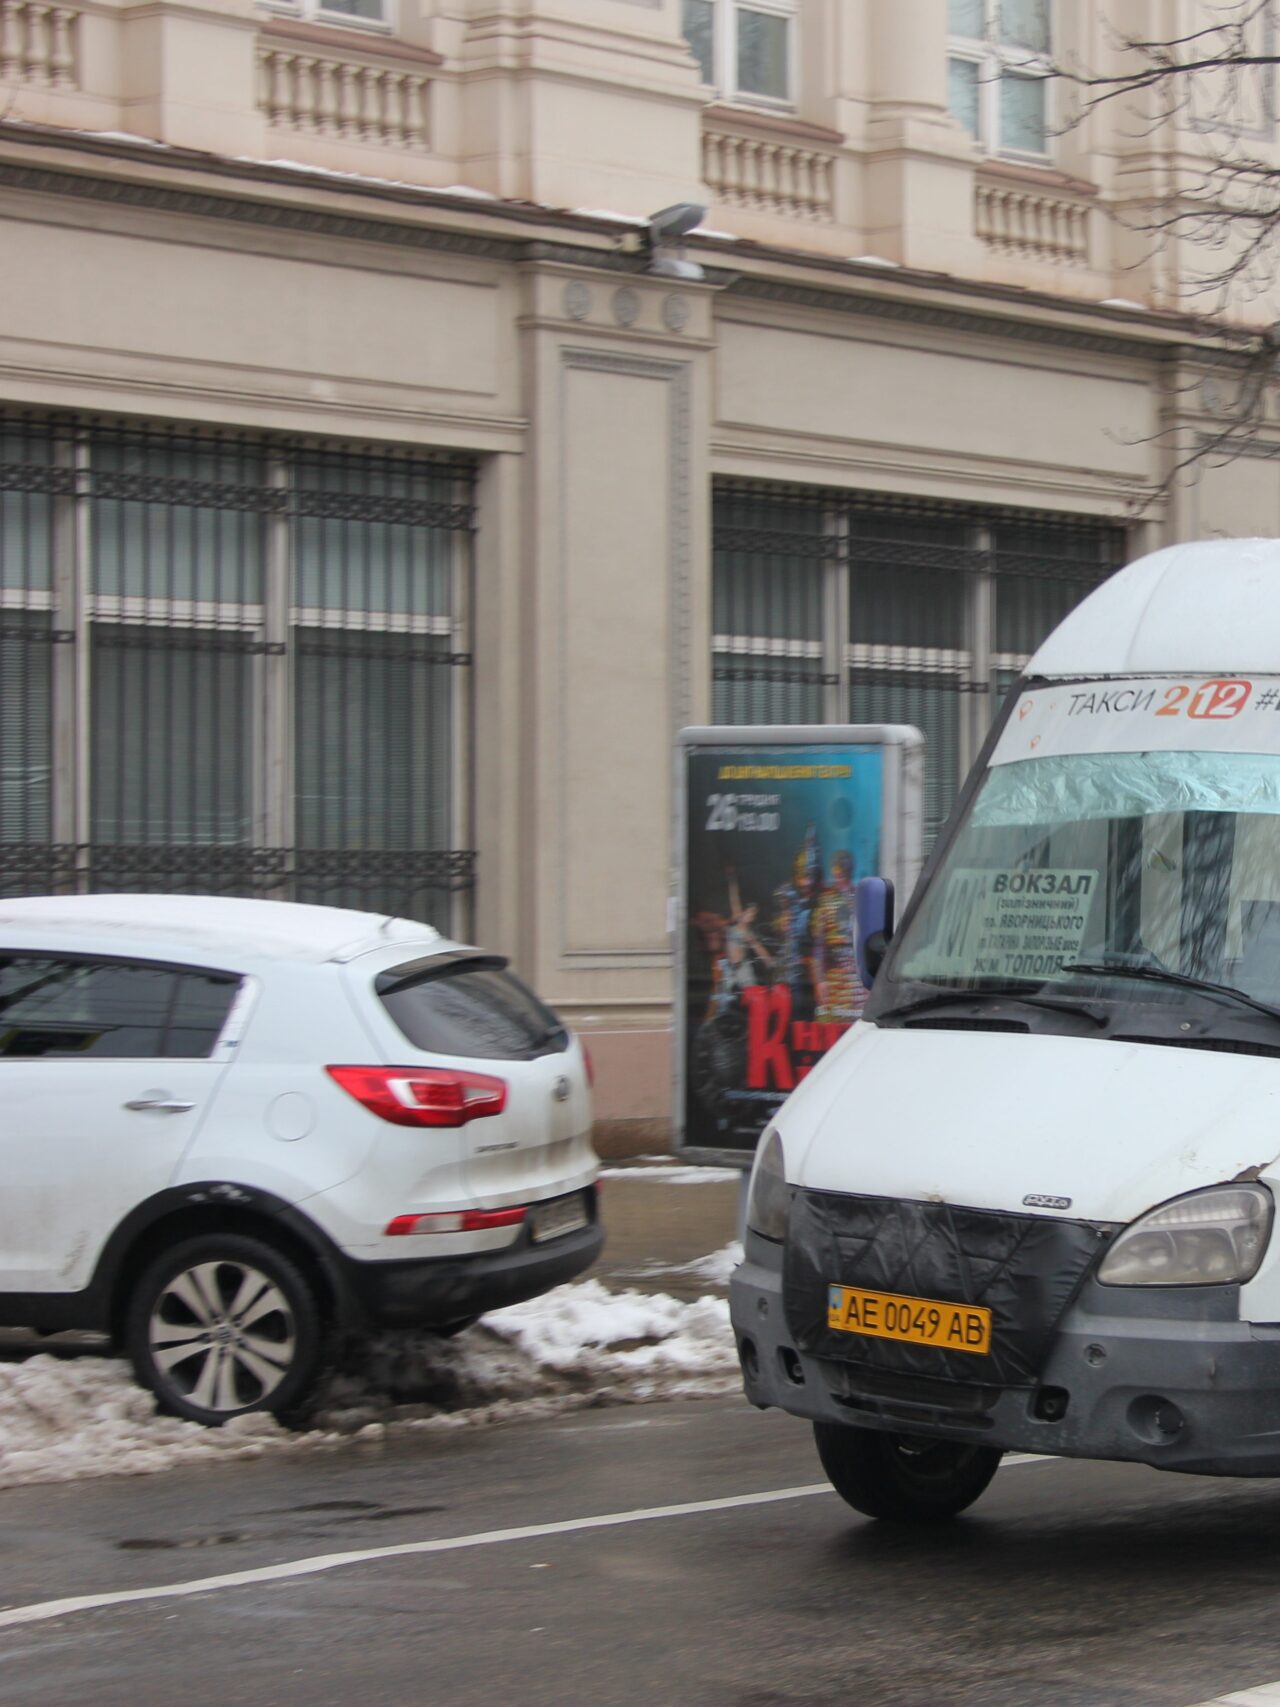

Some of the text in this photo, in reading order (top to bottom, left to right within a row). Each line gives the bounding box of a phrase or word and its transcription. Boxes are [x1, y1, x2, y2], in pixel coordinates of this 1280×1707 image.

[1067, 688, 1155, 716] ТАКСИ
[993, 873, 1092, 895] ВОКЗАЛ
[1004, 953, 1065, 975] ТОПОЛЯ
[884, 1301, 941, 1339] 0049
